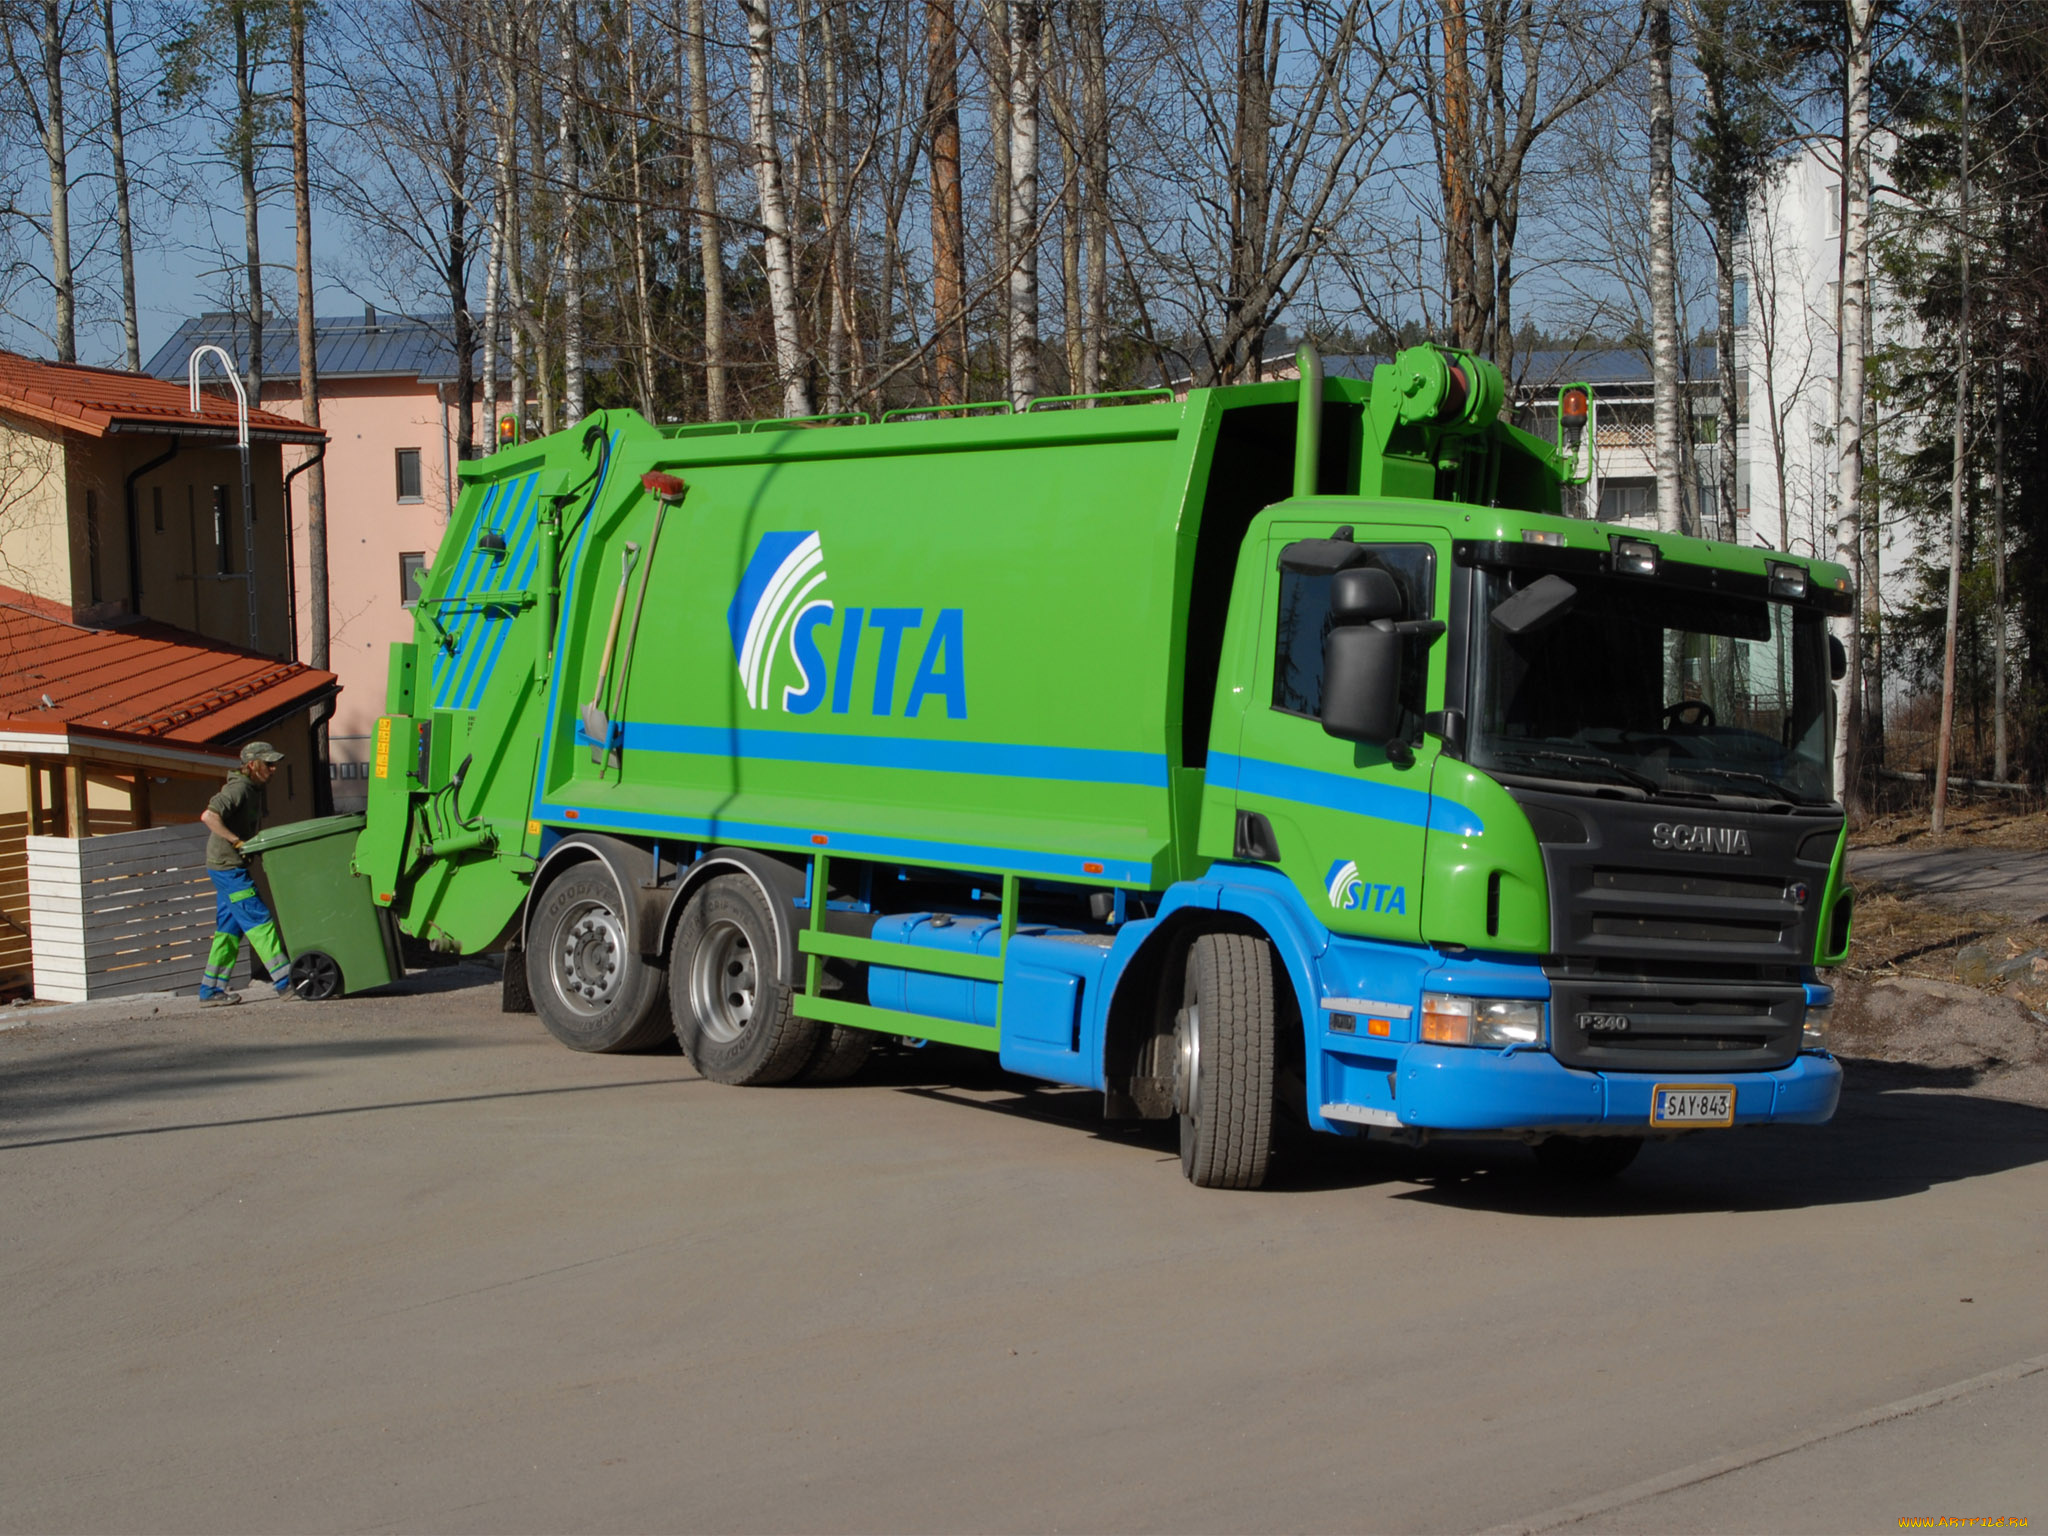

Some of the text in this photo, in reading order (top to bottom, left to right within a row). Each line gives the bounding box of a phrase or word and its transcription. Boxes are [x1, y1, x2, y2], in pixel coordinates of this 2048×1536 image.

[783, 599, 968, 720] SITA
[1652, 822, 1752, 855] SCANIA
[1343, 879, 1406, 916] SITA
[1580, 1015, 1629, 1030] P 340
[1668, 1095, 1727, 1116] SAY-843
